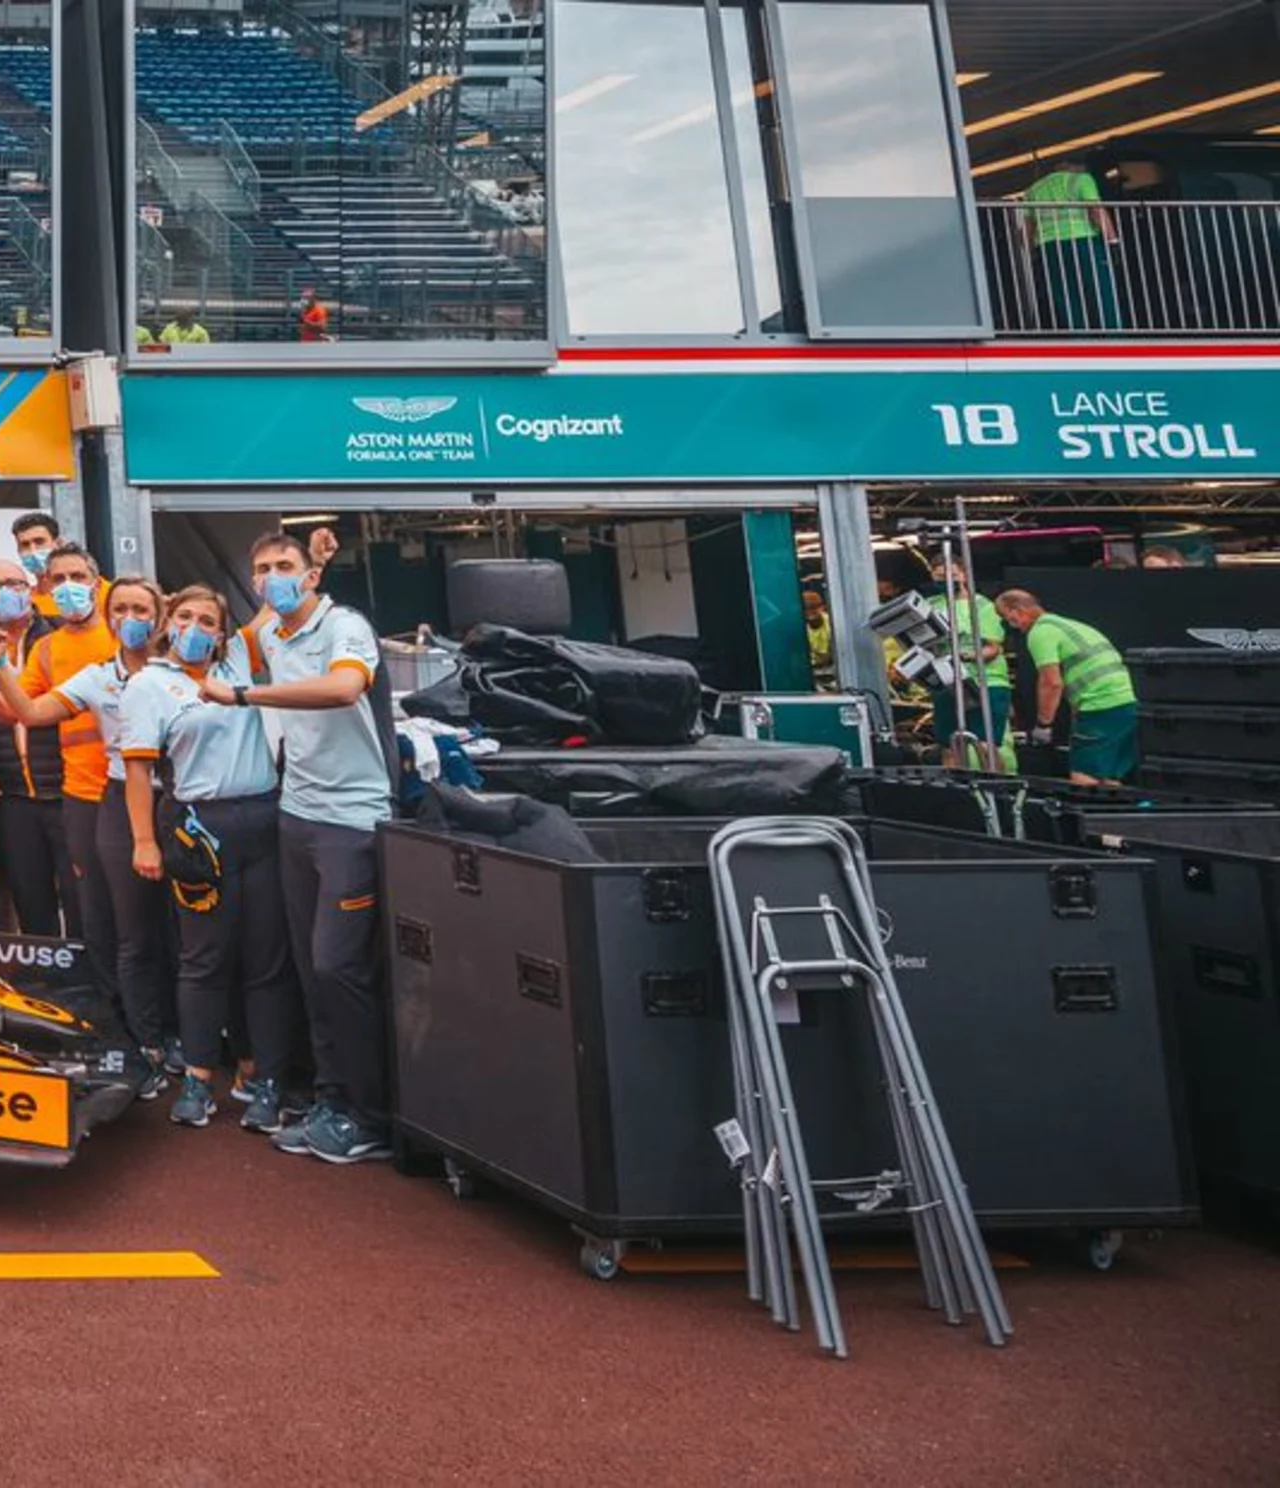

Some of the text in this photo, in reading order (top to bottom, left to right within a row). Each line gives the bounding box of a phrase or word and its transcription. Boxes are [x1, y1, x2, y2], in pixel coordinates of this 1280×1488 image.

[1050, 391, 1170, 417] LANCE
[496, 413, 625, 442] Cognizant
[930, 403, 1020, 446] 18
[346, 432, 474, 448] ASTON MARTIN
[1057, 423, 1258, 459] STROLL
[347, 449, 407, 462] FORMULA
[442, 449, 475, 462] TEAM
